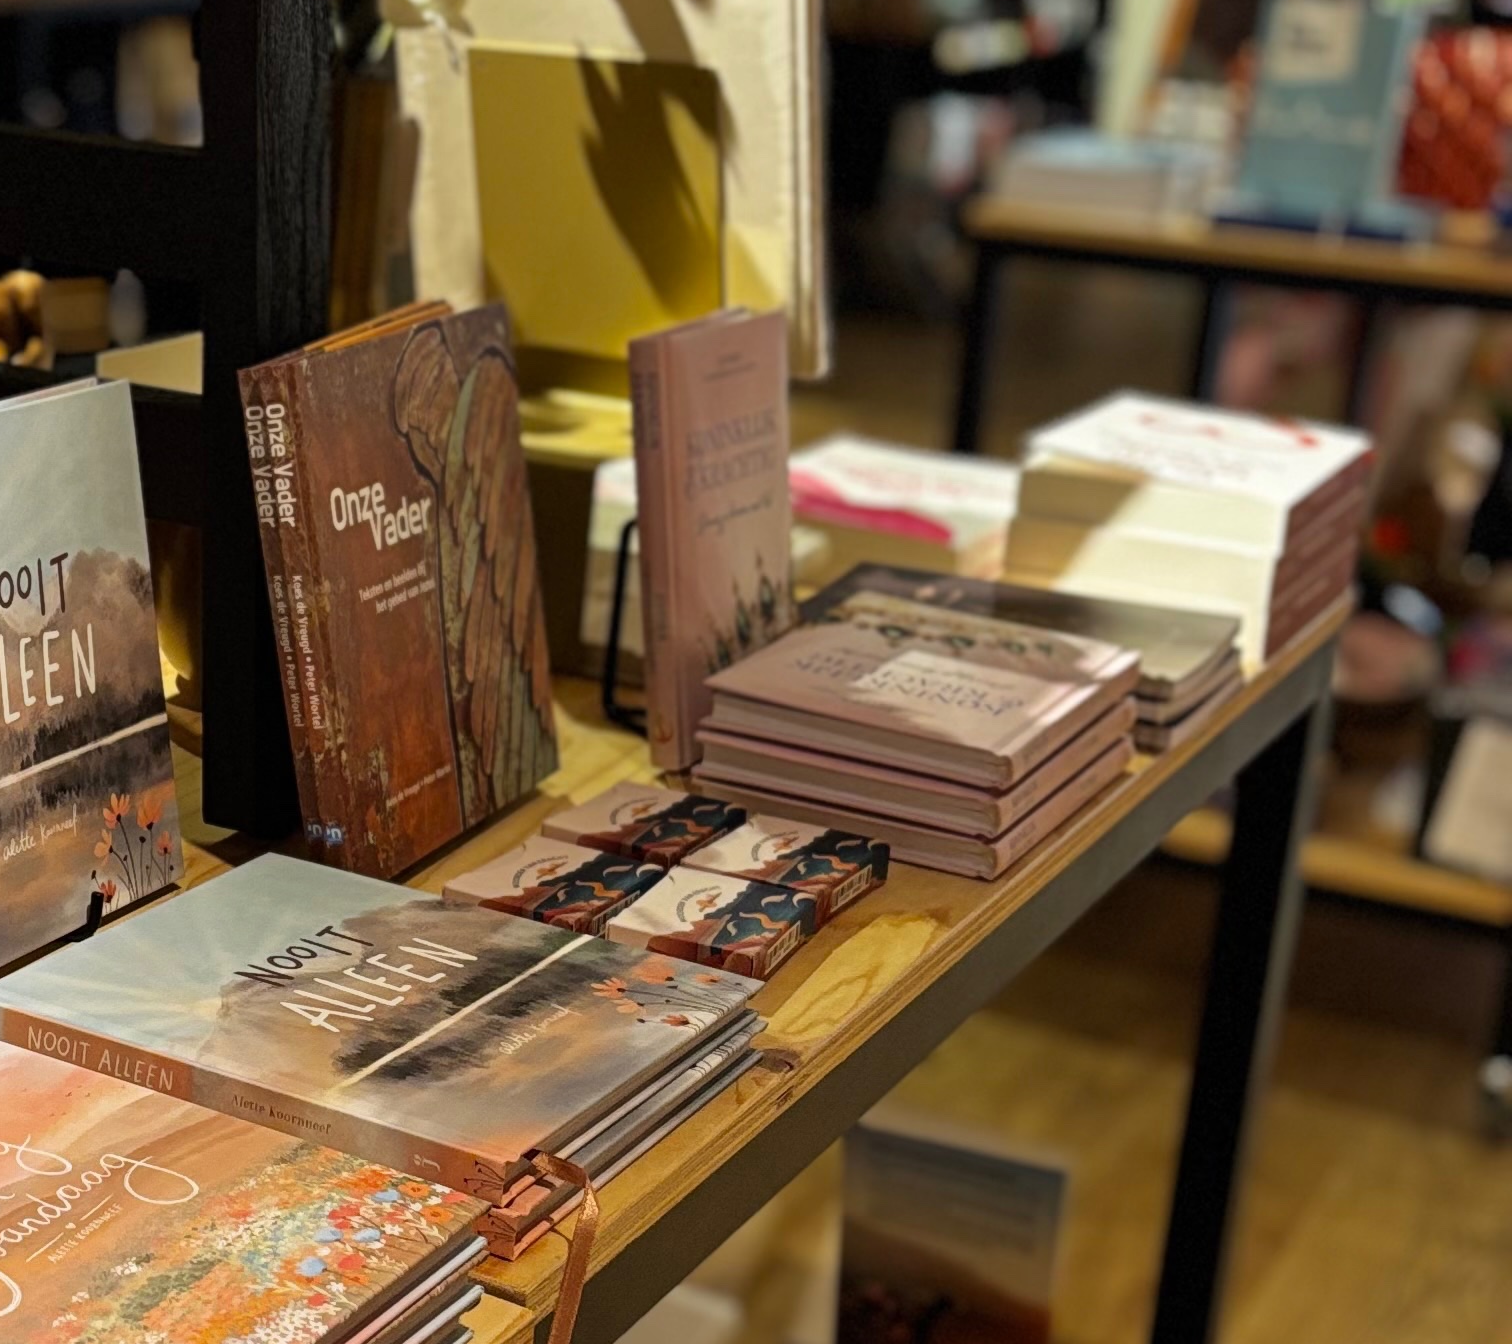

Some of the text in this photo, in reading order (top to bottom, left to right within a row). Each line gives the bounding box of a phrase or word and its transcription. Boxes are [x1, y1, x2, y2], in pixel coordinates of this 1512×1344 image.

[245, 406, 277, 528] Onze Vader
[266, 403, 297, 528] Onze Vader
[330, 482, 386, 531] Onze
[368, 495, 431, 551] Vader
[273, 575, 283, 600] Kees
[277, 601, 287, 614] de
[286, 663, 297, 690] Peter
[292, 575, 324, 730] Kees de Vreugd Peter Wortel
[233, 925, 375, 988] NOOIT
[279, 937, 478, 1033] ALLEEN
[27, 1025, 333, 1135] NOOIT ALLEEN Alette Koornneef
